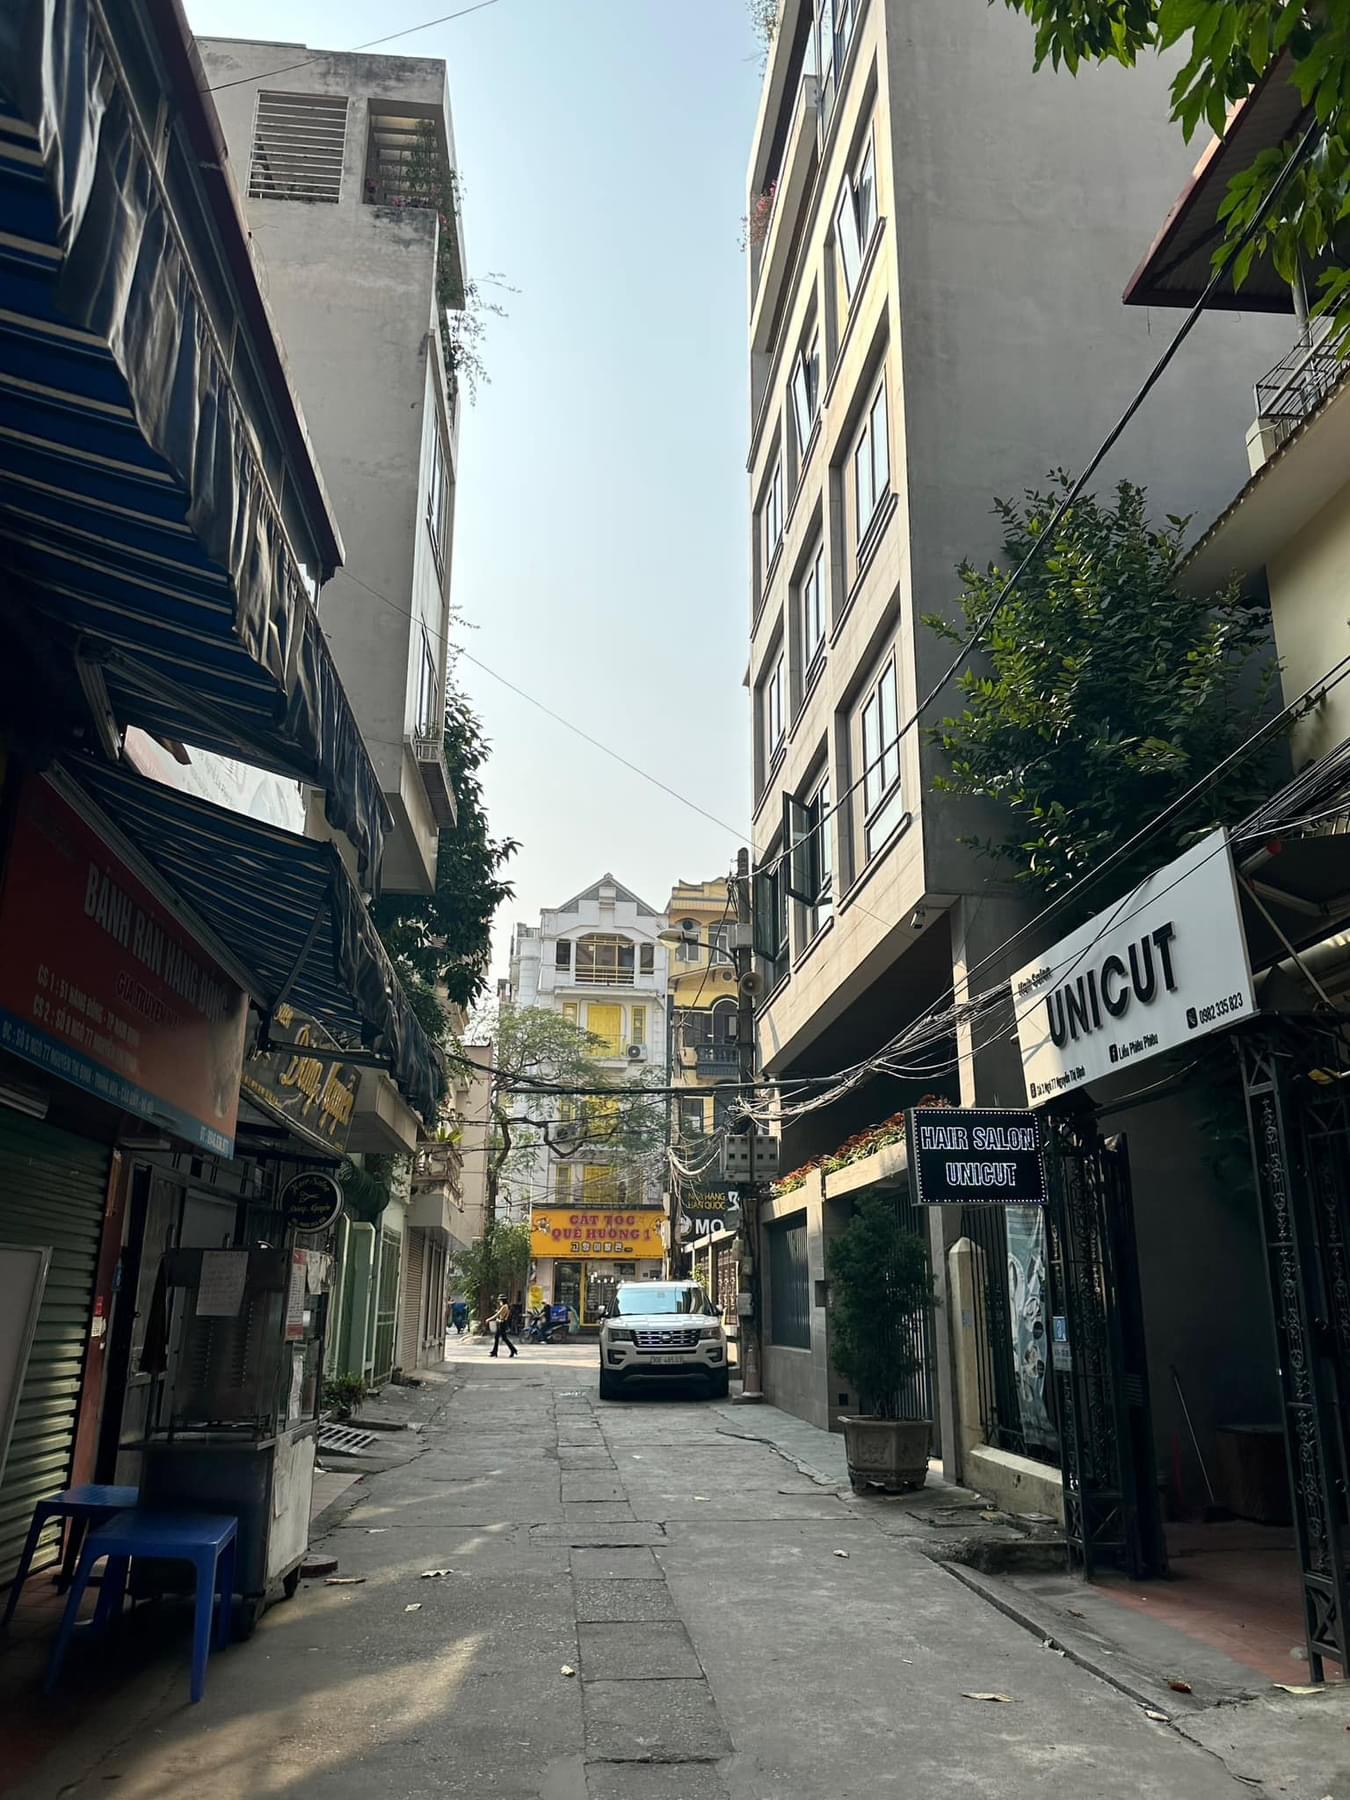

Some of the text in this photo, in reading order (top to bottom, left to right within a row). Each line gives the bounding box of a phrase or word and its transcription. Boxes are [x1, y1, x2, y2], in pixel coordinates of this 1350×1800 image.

[84, 862, 133, 949] BÁNH
[132, 908, 165, 976] RÁN
[1046, 921, 1177, 1048] UNICUT
[1199, 992, 1244, 1025] 0982 335 823
[920, 1127, 1035, 1150] HAIR SALON
[946, 1163, 1016, 1186] UNICUT
[643, 1229, 651, 1240] 1
